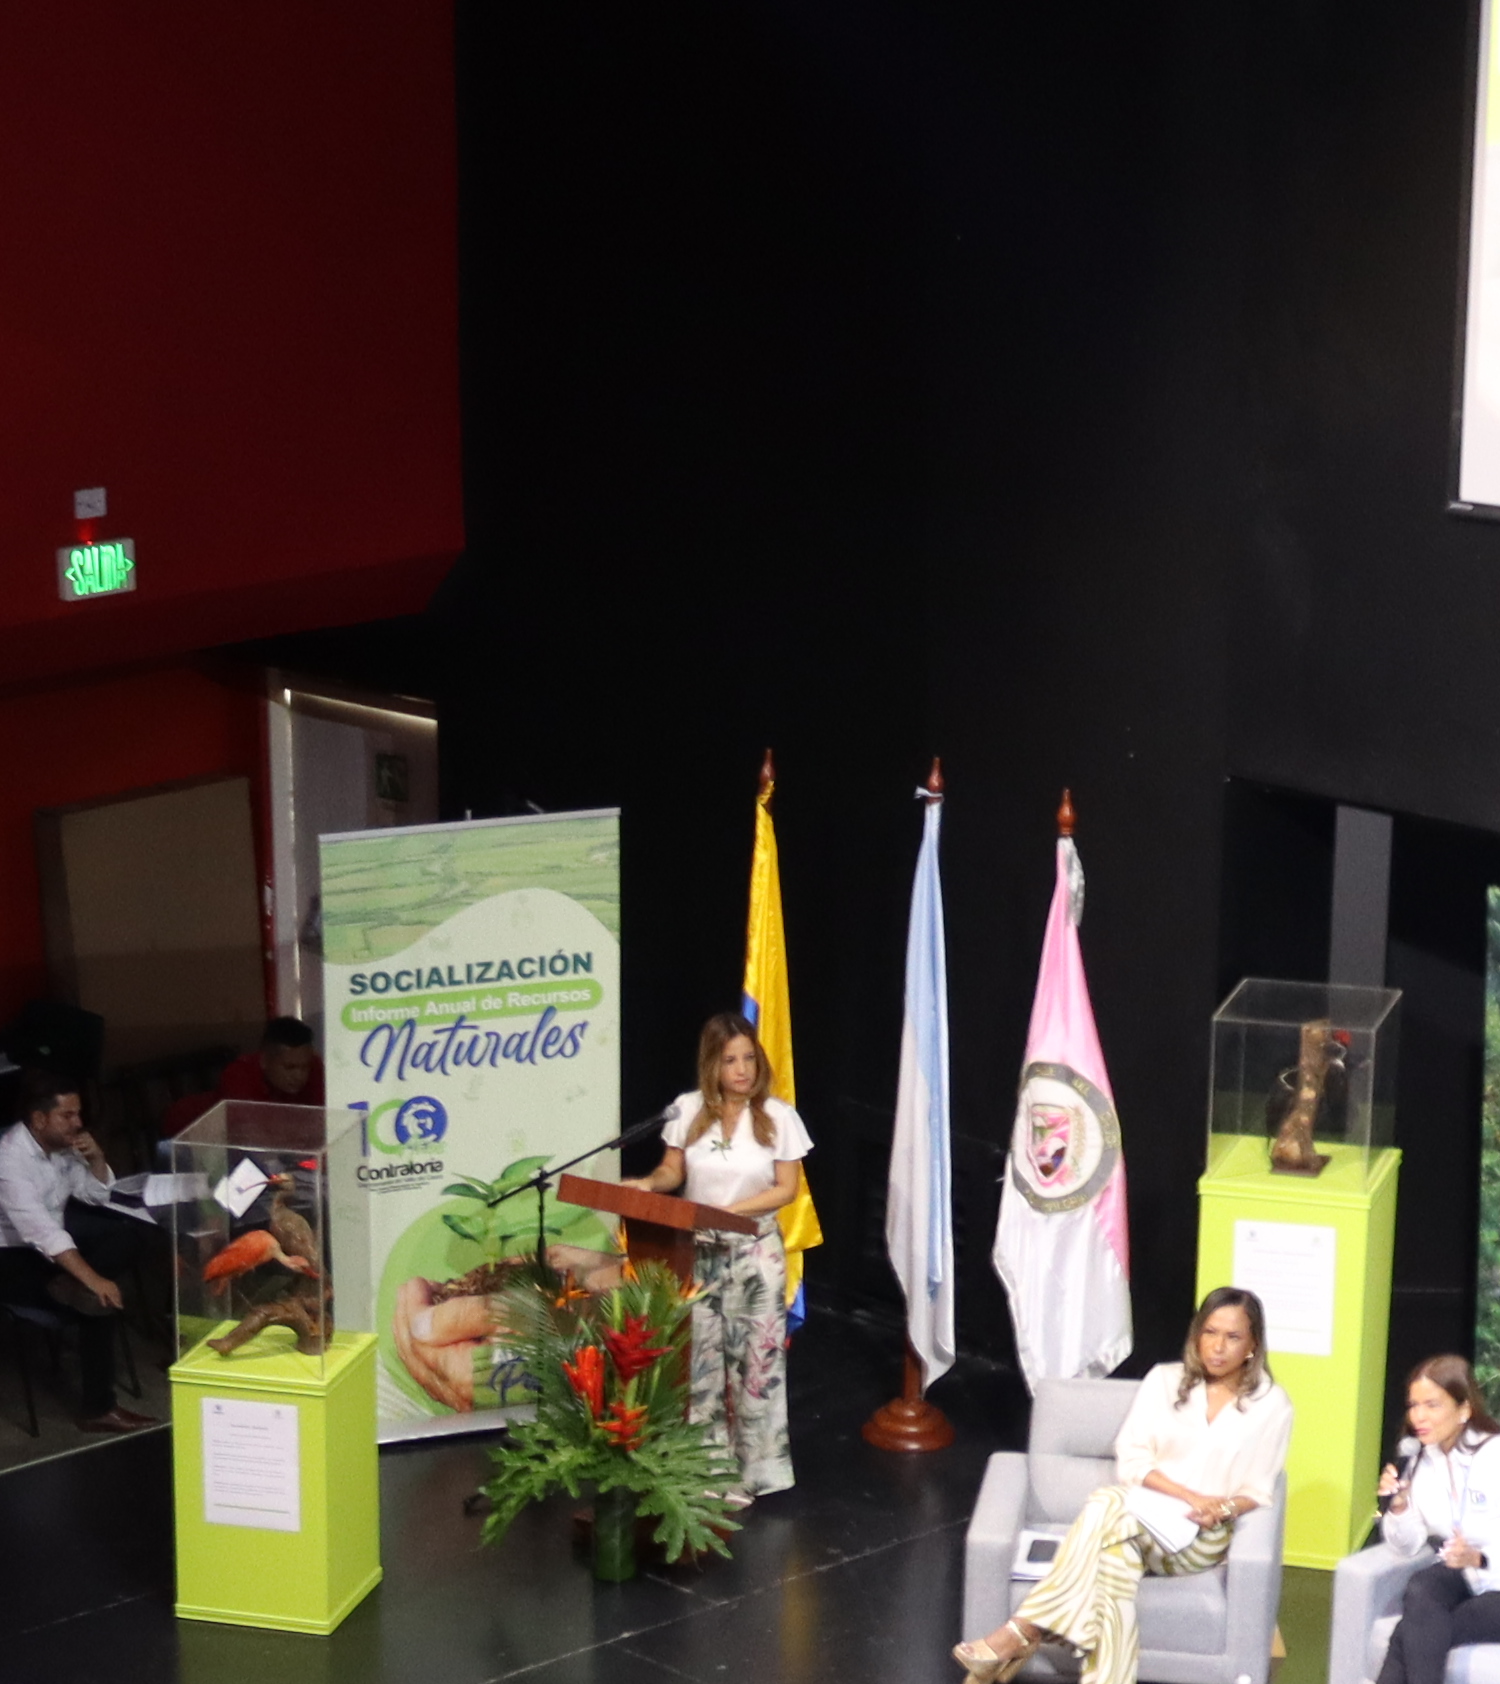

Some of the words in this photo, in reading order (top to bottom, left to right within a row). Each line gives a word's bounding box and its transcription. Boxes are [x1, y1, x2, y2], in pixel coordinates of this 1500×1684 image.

[349, 949, 593, 995] SOCIALIZACIÓN
[352, 1006, 420, 1024] Informe
[425, 996, 477, 1016] Anual
[481, 994, 504, 1011] de
[508, 987, 592, 1008] Recursos
[360, 1005, 590, 1083] Naturales
